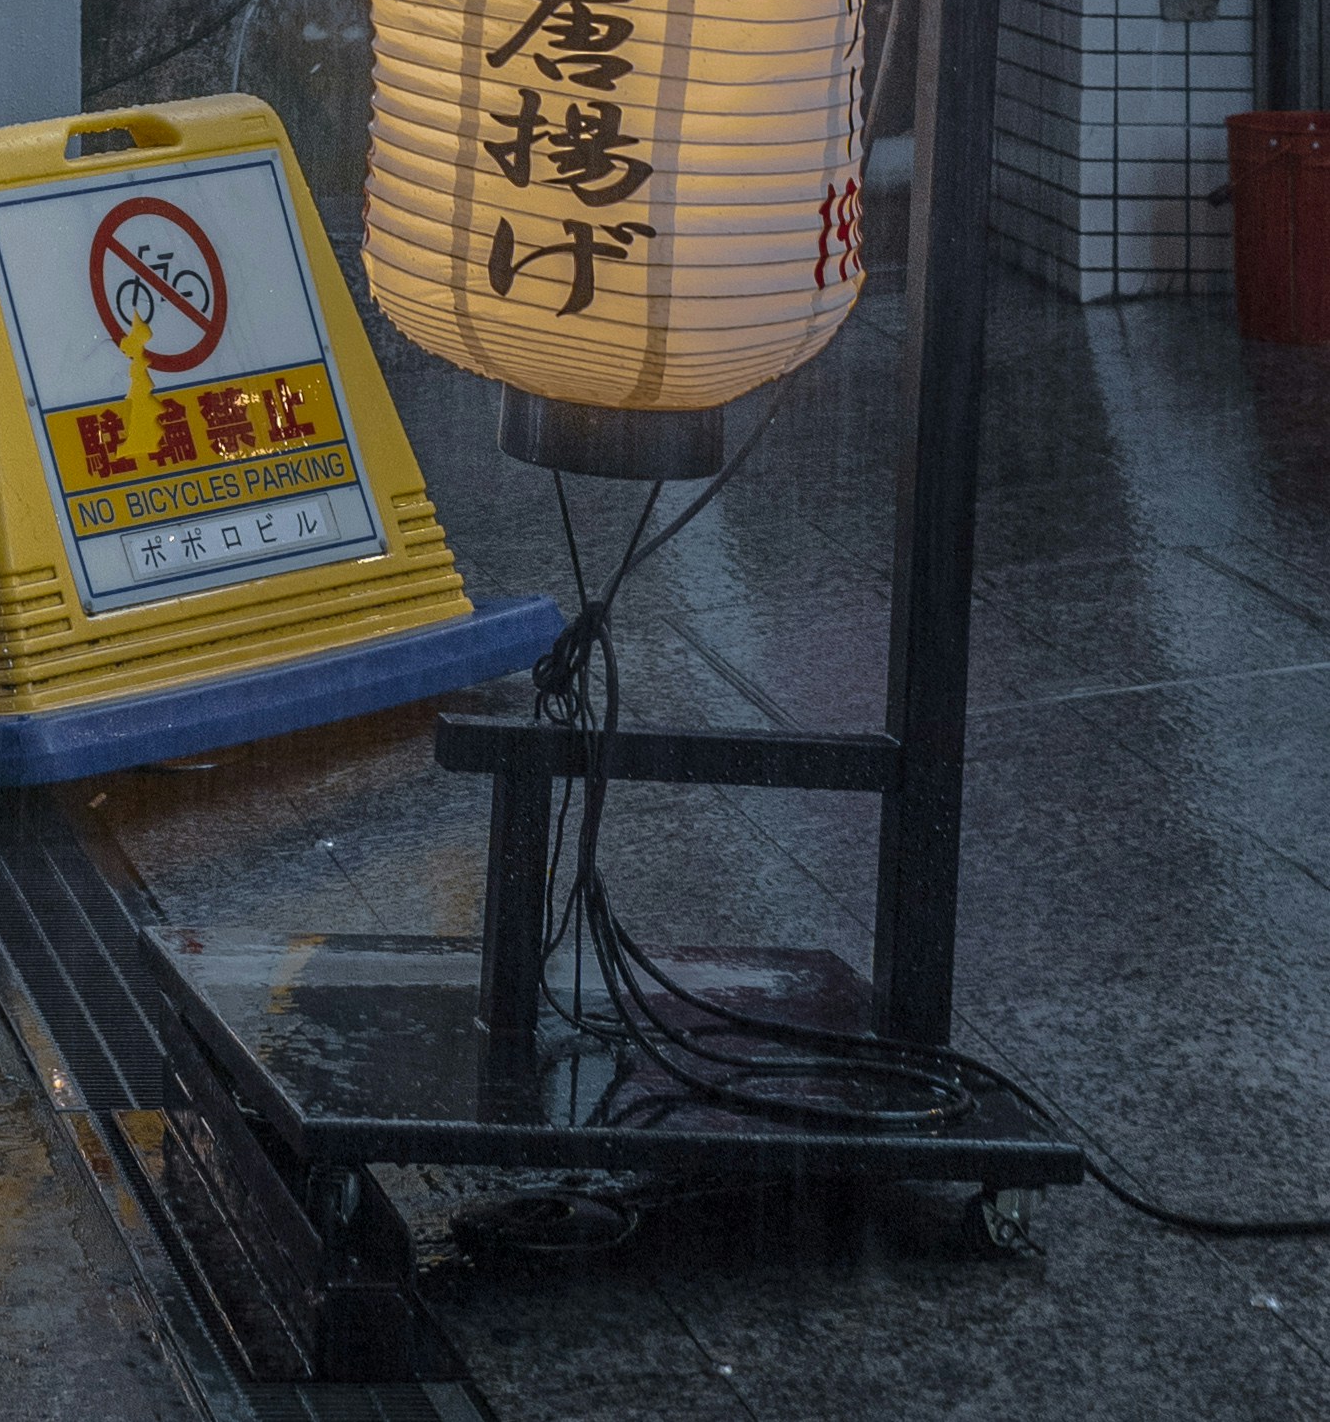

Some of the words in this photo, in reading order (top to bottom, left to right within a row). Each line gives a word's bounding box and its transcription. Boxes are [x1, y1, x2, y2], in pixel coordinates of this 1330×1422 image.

[78, 498, 115, 527] NO
[127, 475, 241, 520] BICYCLES
[246, 454, 346, 493] PARKING
[139, 509, 319, 569] ポポロビル
